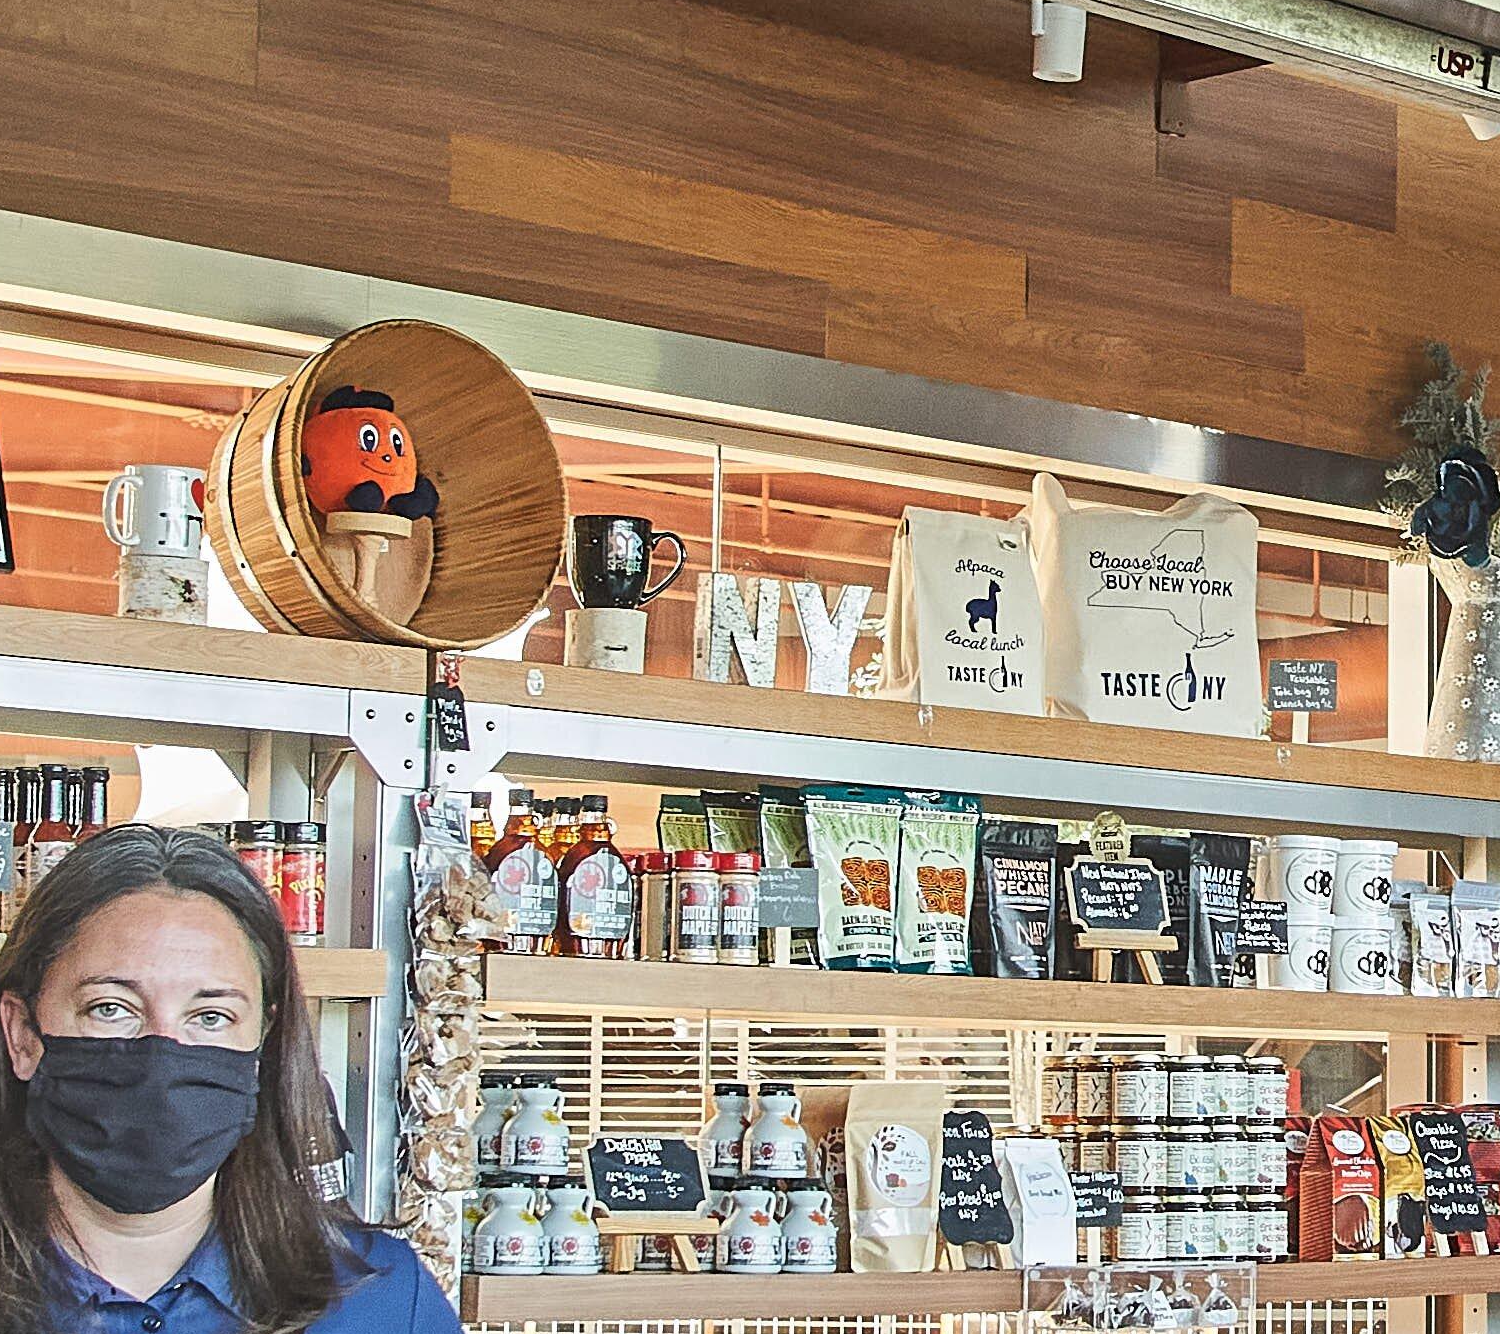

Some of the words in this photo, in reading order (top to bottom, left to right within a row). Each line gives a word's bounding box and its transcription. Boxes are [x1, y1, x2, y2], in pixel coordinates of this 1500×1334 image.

[955, 559, 1005, 579] Alpaca
[1089, 551, 1151, 570] Choose
[1156, 553, 1202, 573] Local
[1106, 575, 1143, 591] BUY
[1150, 577, 1186, 593] NEW
[1190, 579, 1233, 597] YORK
[694, 572, 874, 698] NY
[945, 629, 987, 651] local
[990, 634, 1025, 652] lunch
[948, 666, 986, 683] TASTE
[1310, 663, 1325, 674] NY
[1101, 672, 1161, 697] TASTE
[1203, 676, 1226, 700] NY
[994, 857, 1049, 873] CINNAMON
